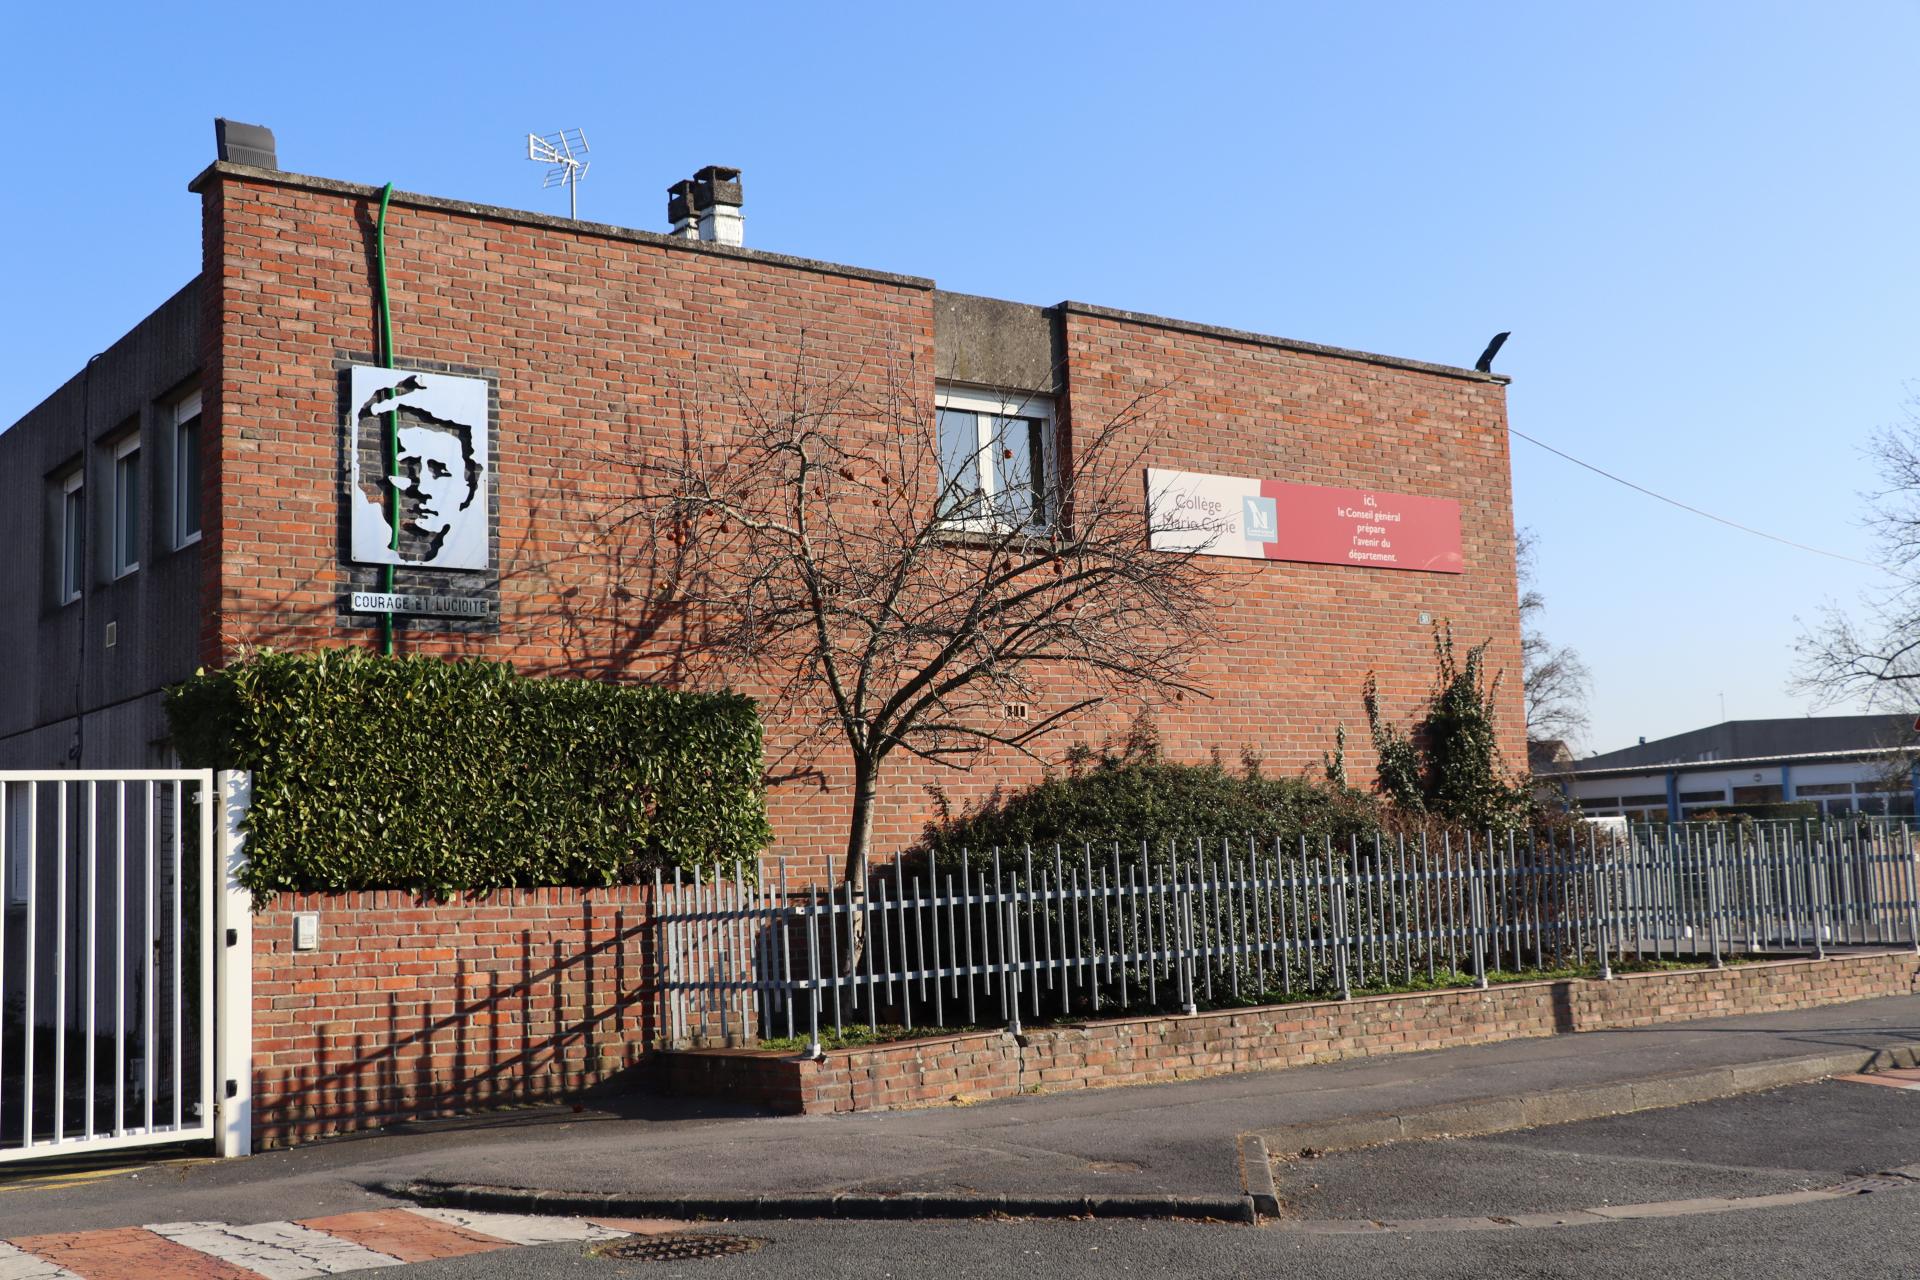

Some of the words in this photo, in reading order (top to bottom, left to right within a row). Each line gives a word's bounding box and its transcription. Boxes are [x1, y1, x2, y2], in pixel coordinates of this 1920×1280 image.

[1175, 494, 1222, 516] Collège
[1363, 494, 1377, 508] ici,
[1337, 507, 1345, 517] le
[1346, 507, 1374, 520] Conseil
[1374, 511, 1401, 523] général
[1202, 517, 1236, 534] Curie
[1357, 523, 1386, 536] prépare
[1353, 535, 1380, 547] l'avenir
[1381, 538, 1391, 548] du
[354, 595, 410, 611] COURAGE
[415, 597, 430, 611] ET
